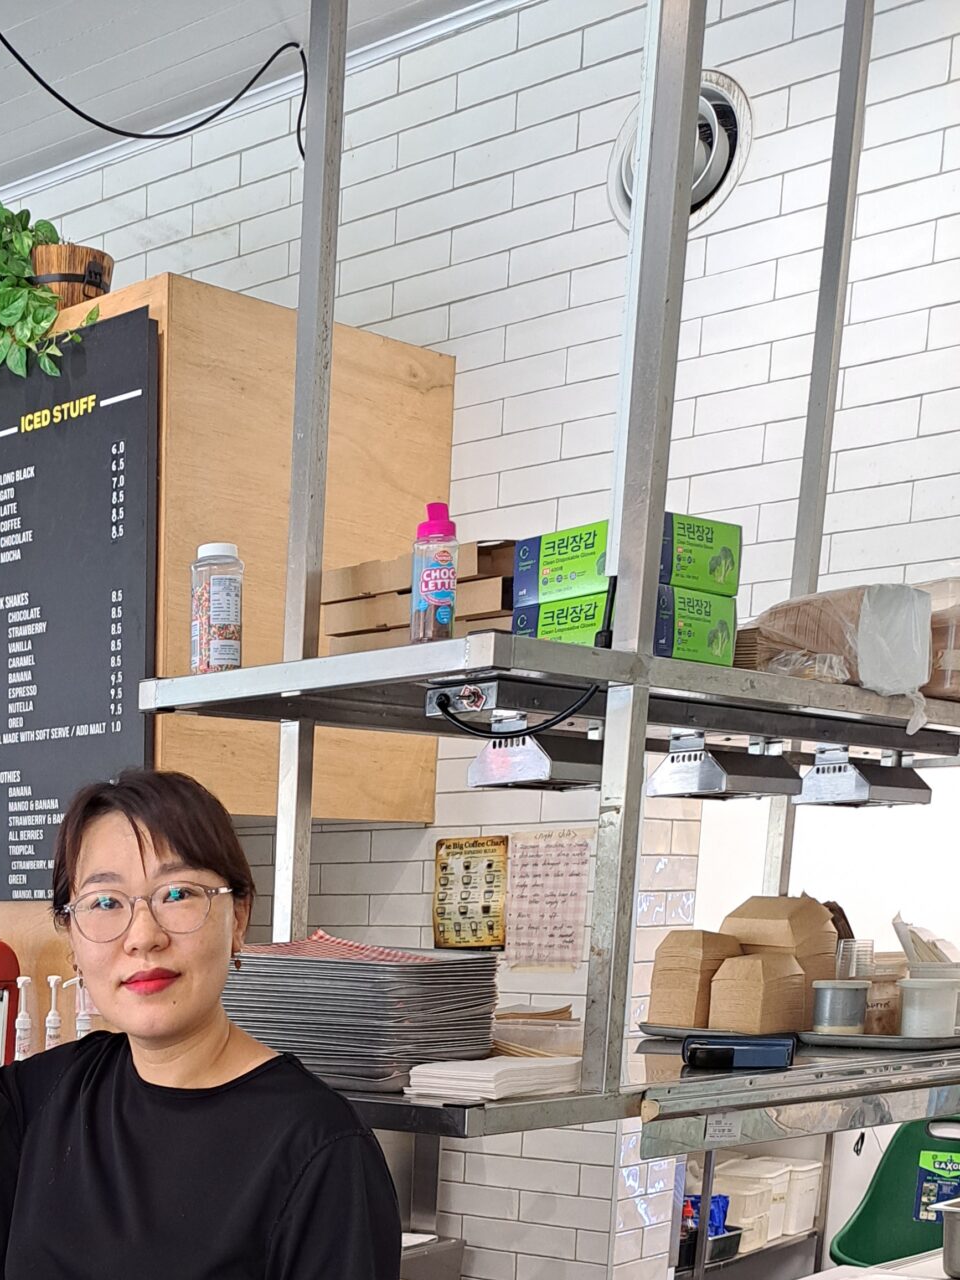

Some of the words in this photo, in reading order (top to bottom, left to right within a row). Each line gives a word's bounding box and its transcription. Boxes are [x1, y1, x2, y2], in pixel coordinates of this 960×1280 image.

[20, 408, 51, 433] ICED
[52, 394, 97, 424] STUFF
[0, 471, 15, 486] LONG
[15, 466, 35, 481] BLACK
[111, 474, 125, 489] 7.0
[111, 490, 125, 504] 8.5
[0, 502, 18, 518] LATTE
[111, 507, 125, 522] 8.5
[0, 517, 22, 533] COFFEE
[677, 522, 714, 543] 크린장갑
[0, 530, 33, 549] CHOCOLATE
[543, 530, 598, 558] 크린장갑
[0, 549, 22, 564] MOCHA
[4, 592, 29, 609] SHAKES
[678, 597, 712, 616] 크린장갑
[8, 606, 41, 623] CHOCOLATE
[542, 602, 598, 627] 크린장갑
[8, 621, 47, 639] STRAWBERRY
[8, 640, 32, 654] VANILLA
[8, 654, 36, 669] CARAMEL
[8, 670, 32, 684] BANANA
[8, 684, 38, 699] ESPRESSO
[8, 700, 34, 714] NUTELLA
[8, 717, 24, 729] OREO
[111, 721, 121, 733] 1.0
[2, 732, 20, 744] MADE
[20, 731, 35, 742] WITH
[35, 729, 50, 741] SOFT
[50, 727, 70, 739] SERVE
[75, 724, 89, 736] ADD
[89, 722, 106, 735] MALT
[8, 786, 32, 797] BANANA
[8, 801, 29, 812] MANGO
[35, 799, 58, 810] BANANA
[8, 815, 46, 827] STRAWBERRY
[9, 831, 19, 841] ALL
[20, 830, 43, 840] BERRIES
[9, 845, 35, 855] TROPICAL
[464, 840, 485, 848] Coffee
[486, 839, 505, 847] Chart
[8, 875, 27, 884] GREEN
